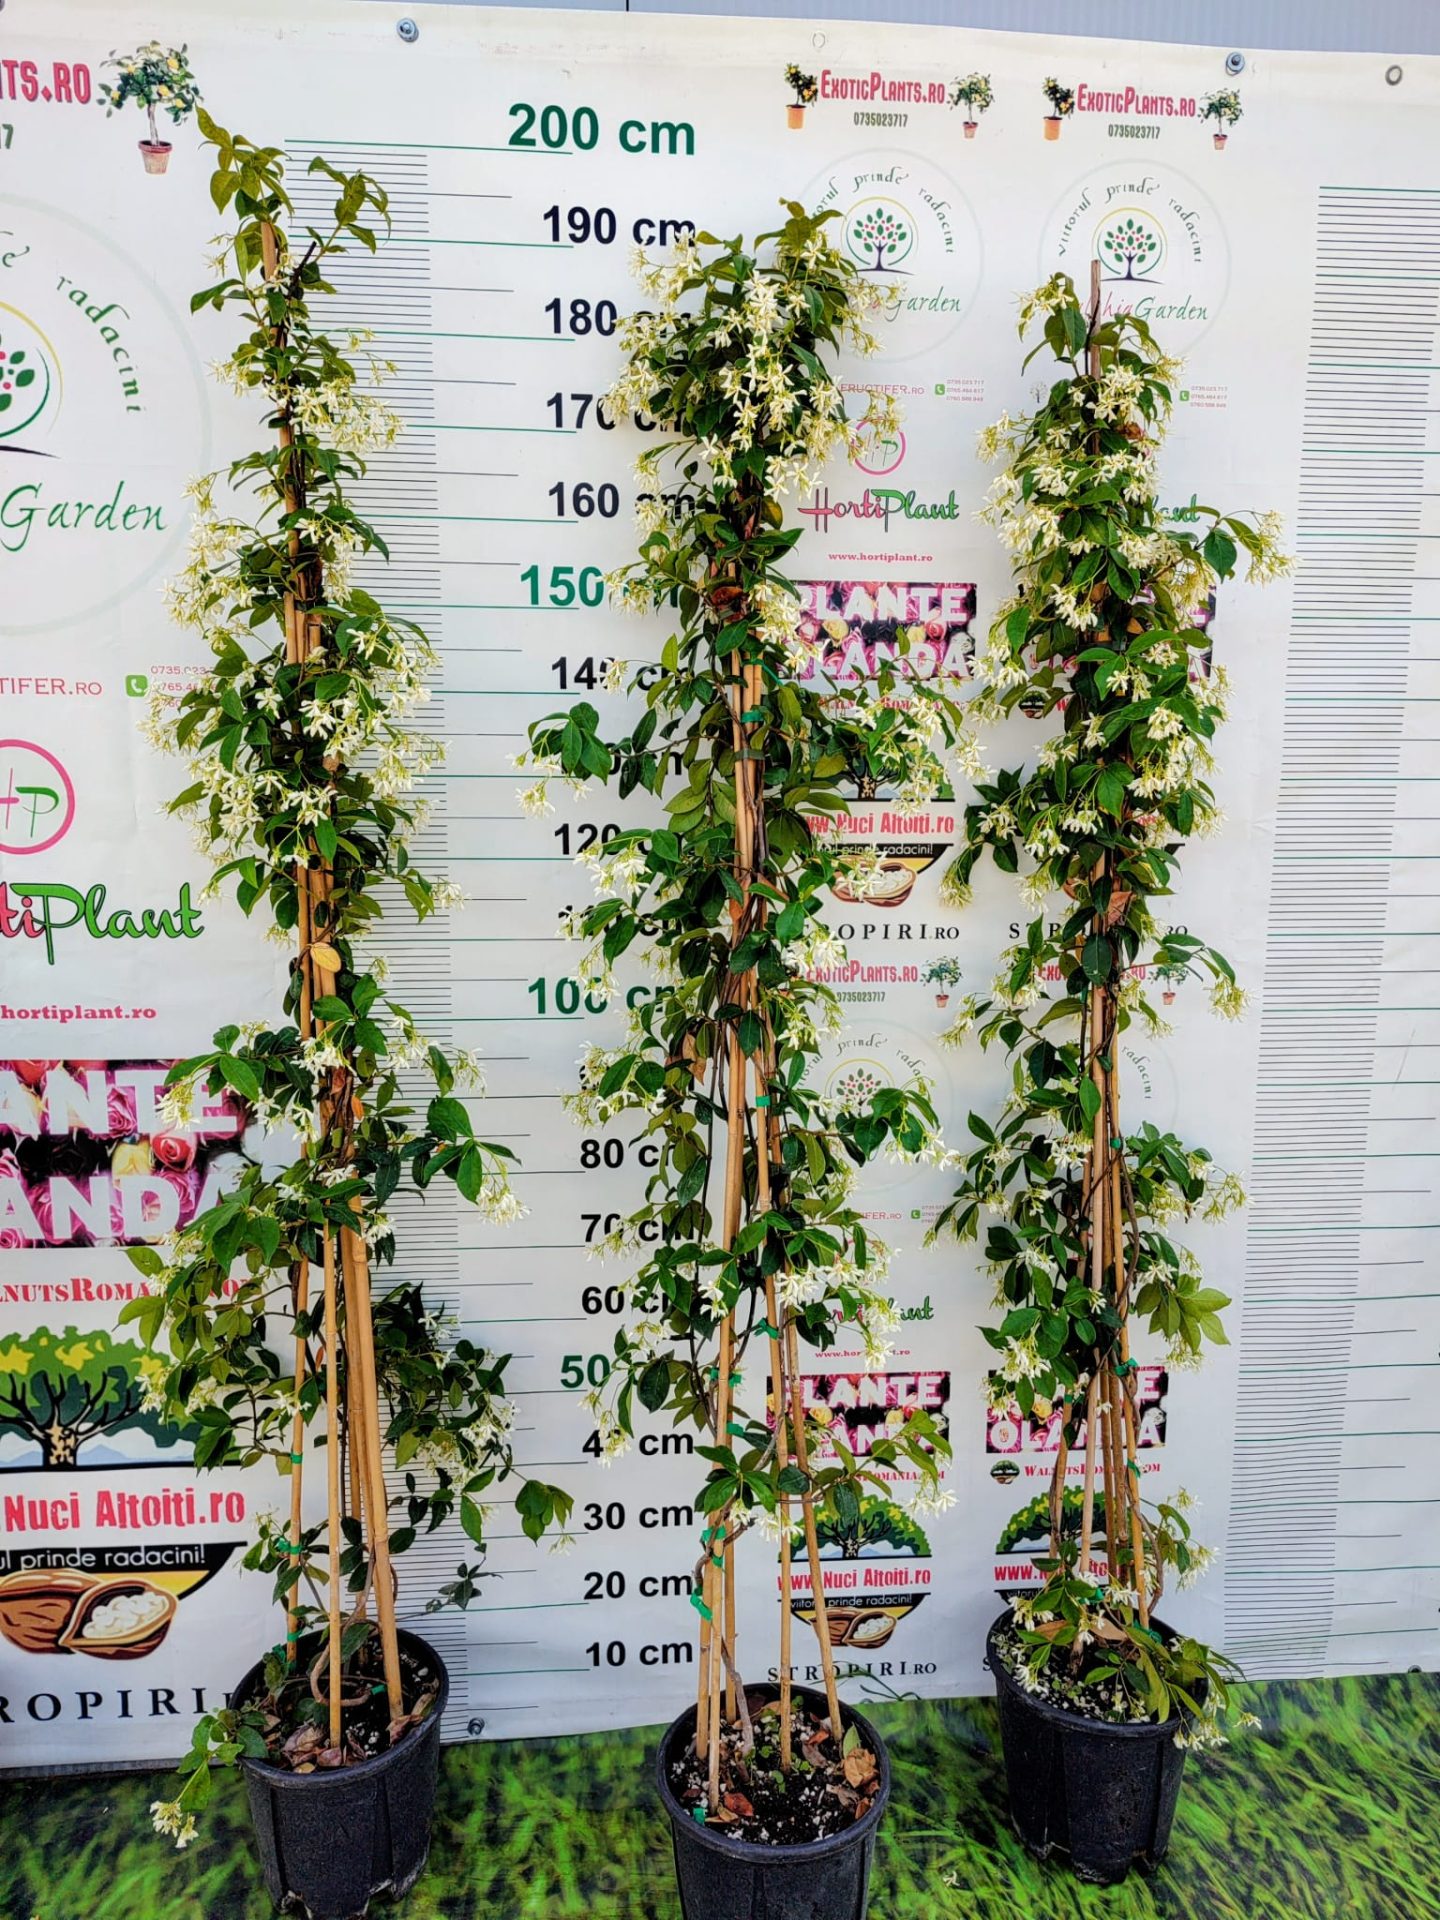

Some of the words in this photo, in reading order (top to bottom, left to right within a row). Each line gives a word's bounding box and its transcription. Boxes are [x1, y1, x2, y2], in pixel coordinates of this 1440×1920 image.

[0, 59, 91, 104] TS.RO
[508, 103, 600, 150] 200
[619, 119, 695, 155] cm
[853, 111, 908, 128] 0735023717
[1107, 123, 1161, 140] 0735023717
[543, 205, 617, 245] 190
[632, 217, 696, 248] cm
[545, 298, 618, 336] 180
[56, 275, 146, 413] radacini
[549, 482, 620, 518] 160
[798, 487, 959, 533] HortiPlant
[0, 480, 167, 552] Garden
[829, 552, 933, 563] www.hortiplant.ro
[521, 565, 605, 607] 150
[896, 1049, 926, 1077] rada
[580, 1139, 624, 1168] 80
[582, 1286, 624, 1314] 60
[560, 1354, 610, 1388] 50
[639, 1432, 693, 1456] cm
[96, 1488, 246, 1530] Altoiti.ro
[583, 1502, 625, 1530] 30
[639, 1505, 693, 1528] cm
[20, 1547, 96, 1571] prinde
[105, 1544, 206, 1567] radacini!
[583, 1571, 625, 1600] 20
[639, 1575, 693, 1598] cm
[863, 1567, 931, 1586] Altoiti.ro
[585, 1641, 626, 1667] 10
[639, 1642, 693, 1665] cm
